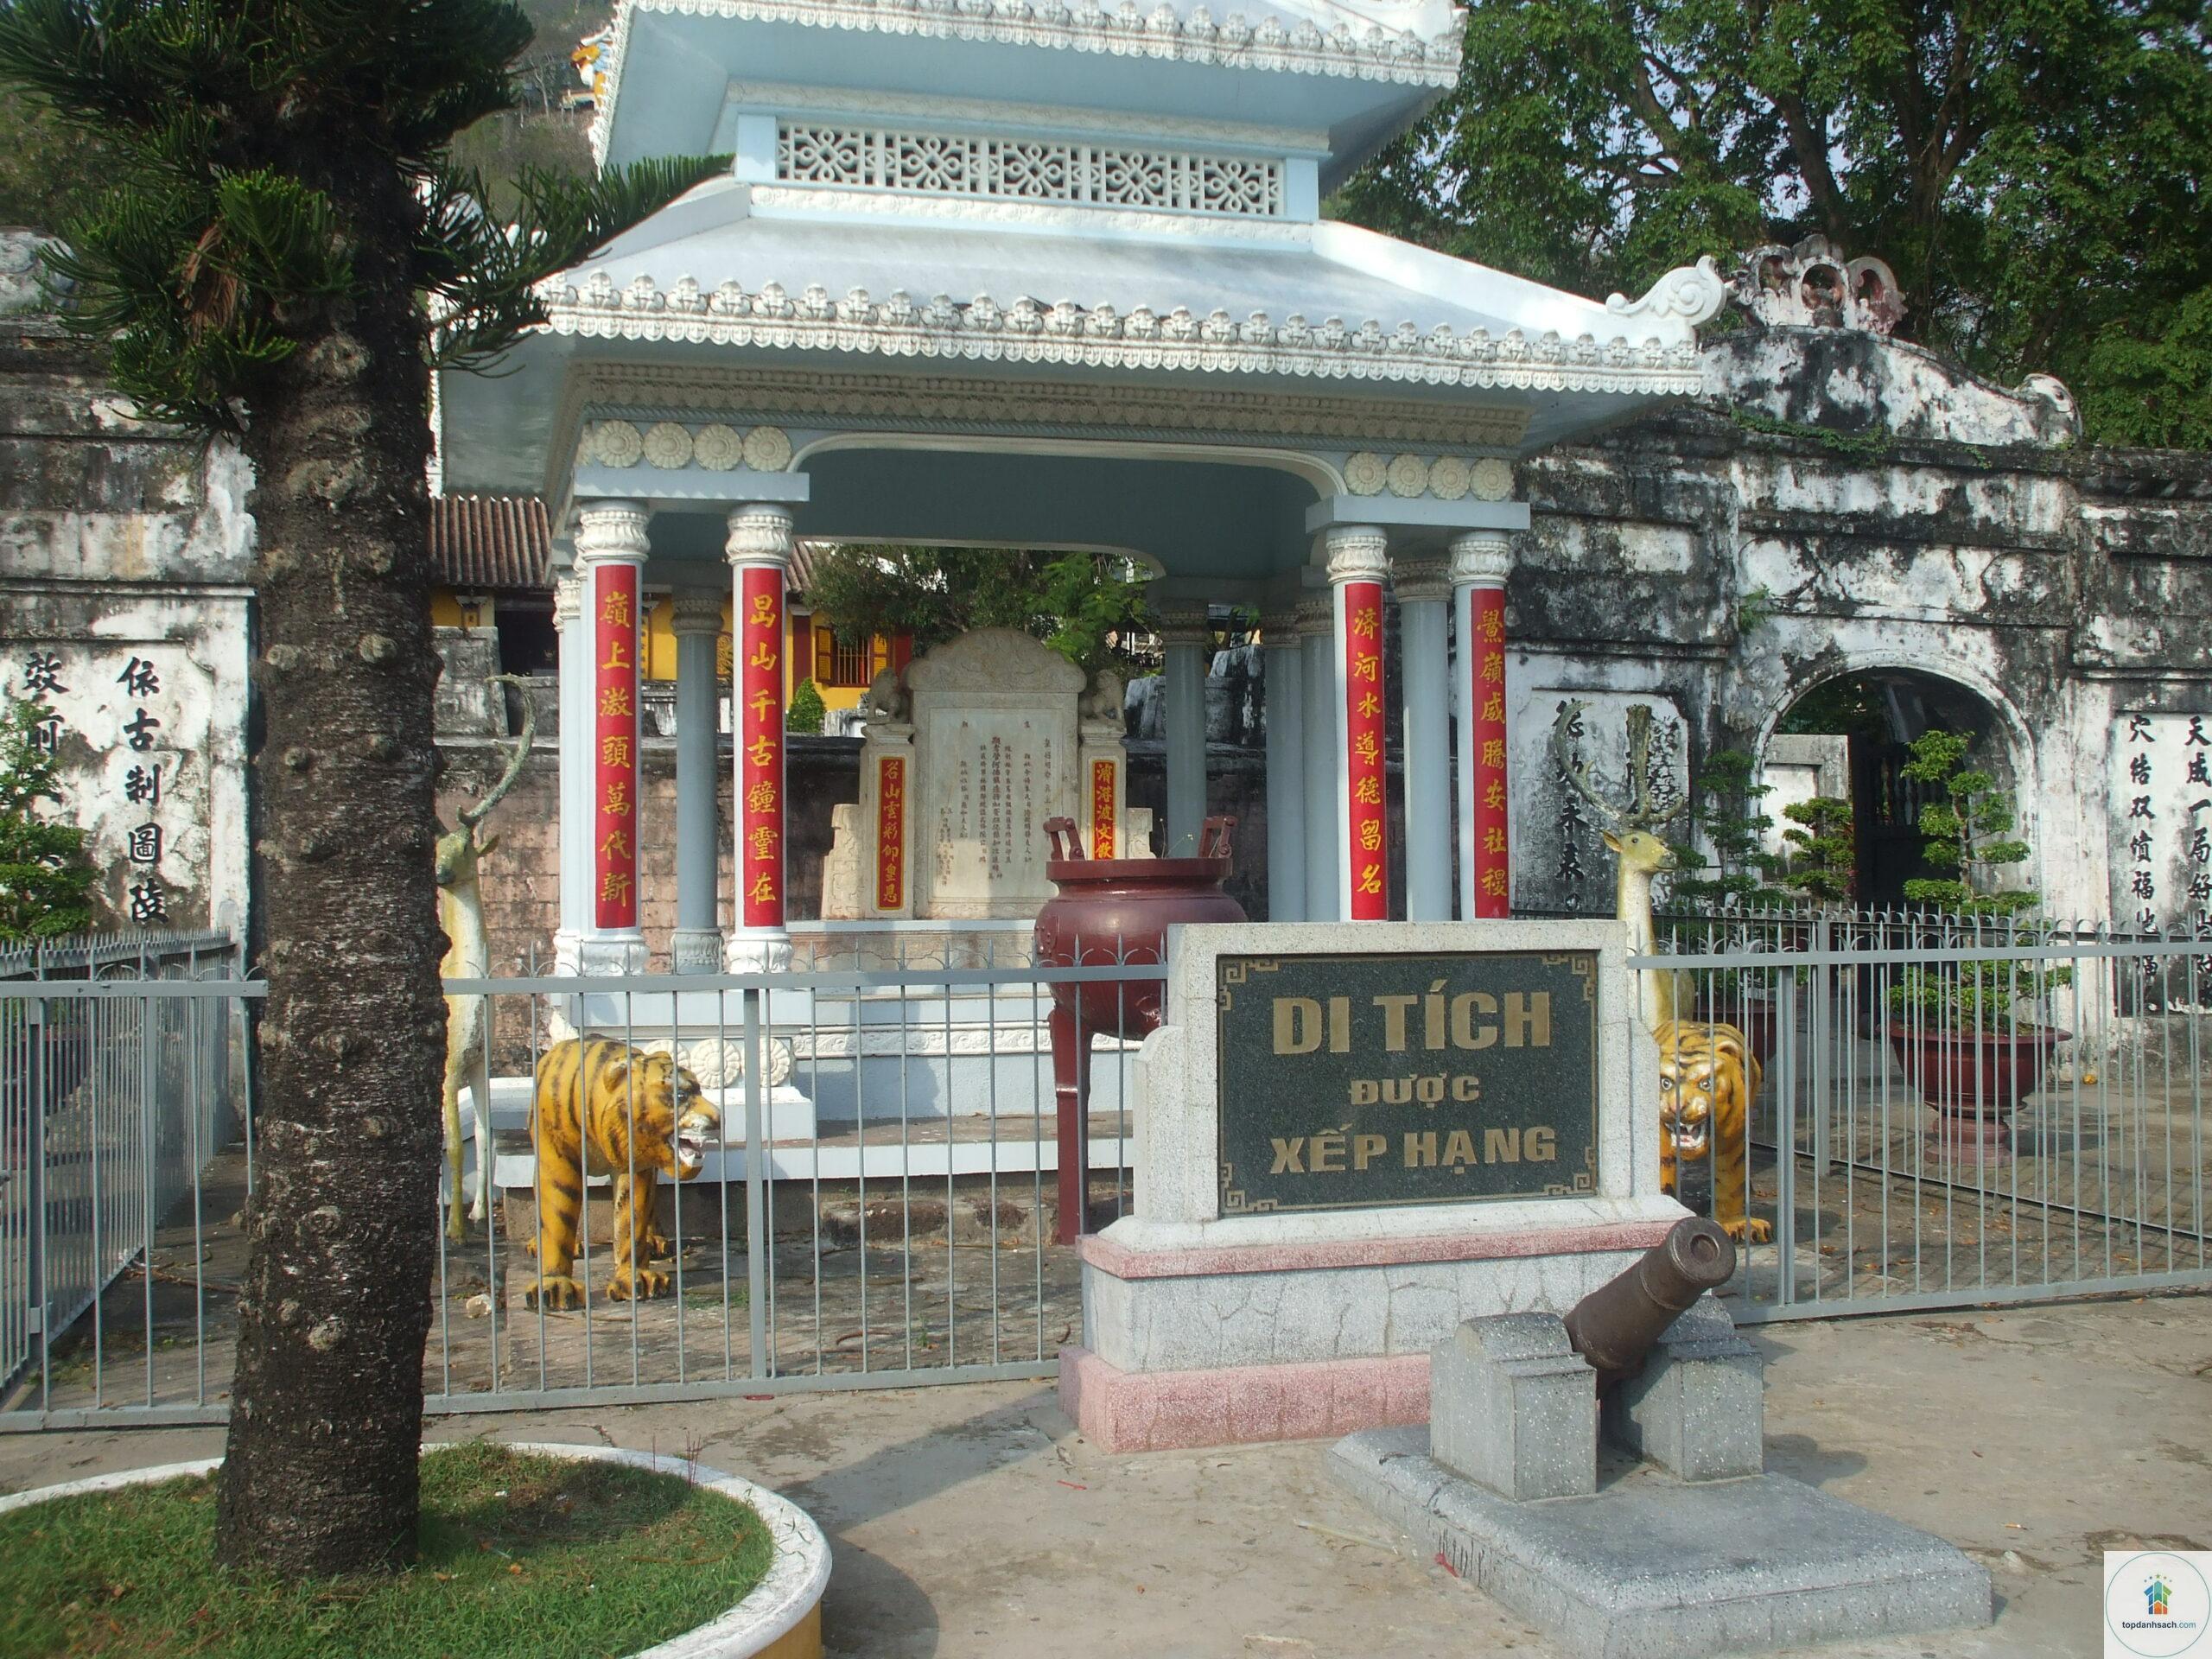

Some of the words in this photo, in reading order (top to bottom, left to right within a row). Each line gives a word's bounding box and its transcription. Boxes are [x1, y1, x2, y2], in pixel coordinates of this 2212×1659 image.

[1272, 995, 1351, 1054] DI
[1373, 979, 1550, 1052] TÍCH
[1348, 1071, 1480, 1109] ĐƯỢC
[1270, 1122, 1388, 1174] XẾP
[1403, 1126, 1557, 1174] HẠNG
